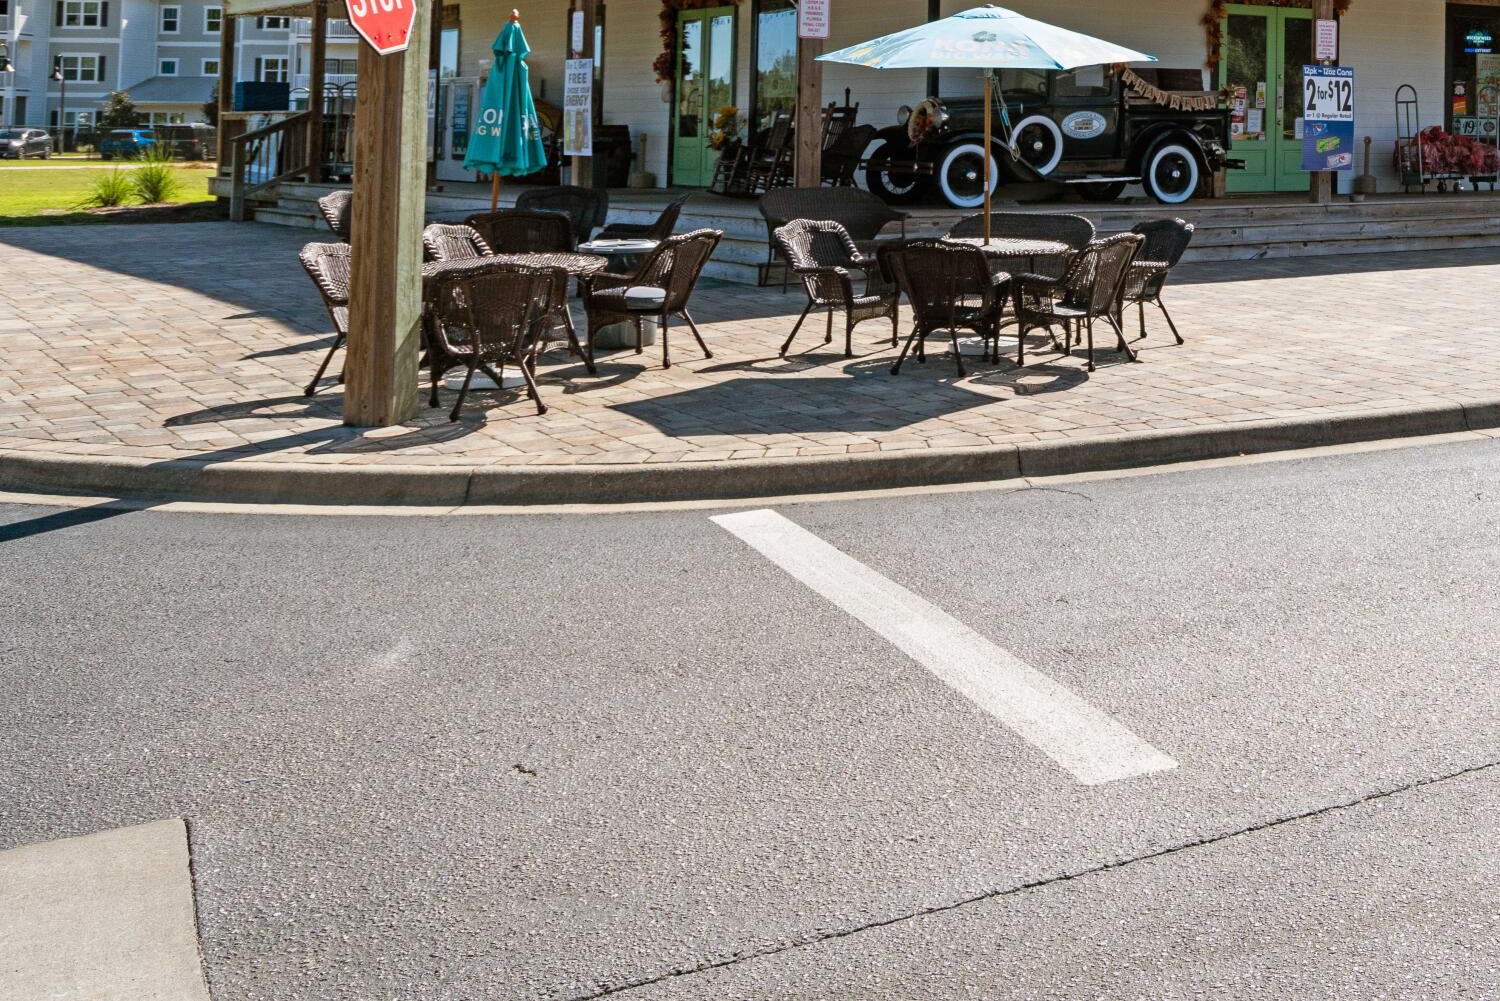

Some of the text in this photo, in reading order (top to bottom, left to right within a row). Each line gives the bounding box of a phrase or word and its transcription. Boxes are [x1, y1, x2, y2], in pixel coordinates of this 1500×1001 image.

[568, 73, 587, 84] FREE
[1336, 69, 1353, 77] Cans
[1126, 71, 1214, 107] THANKFUL
[1306, 79, 1352, 112] 2 for $12
